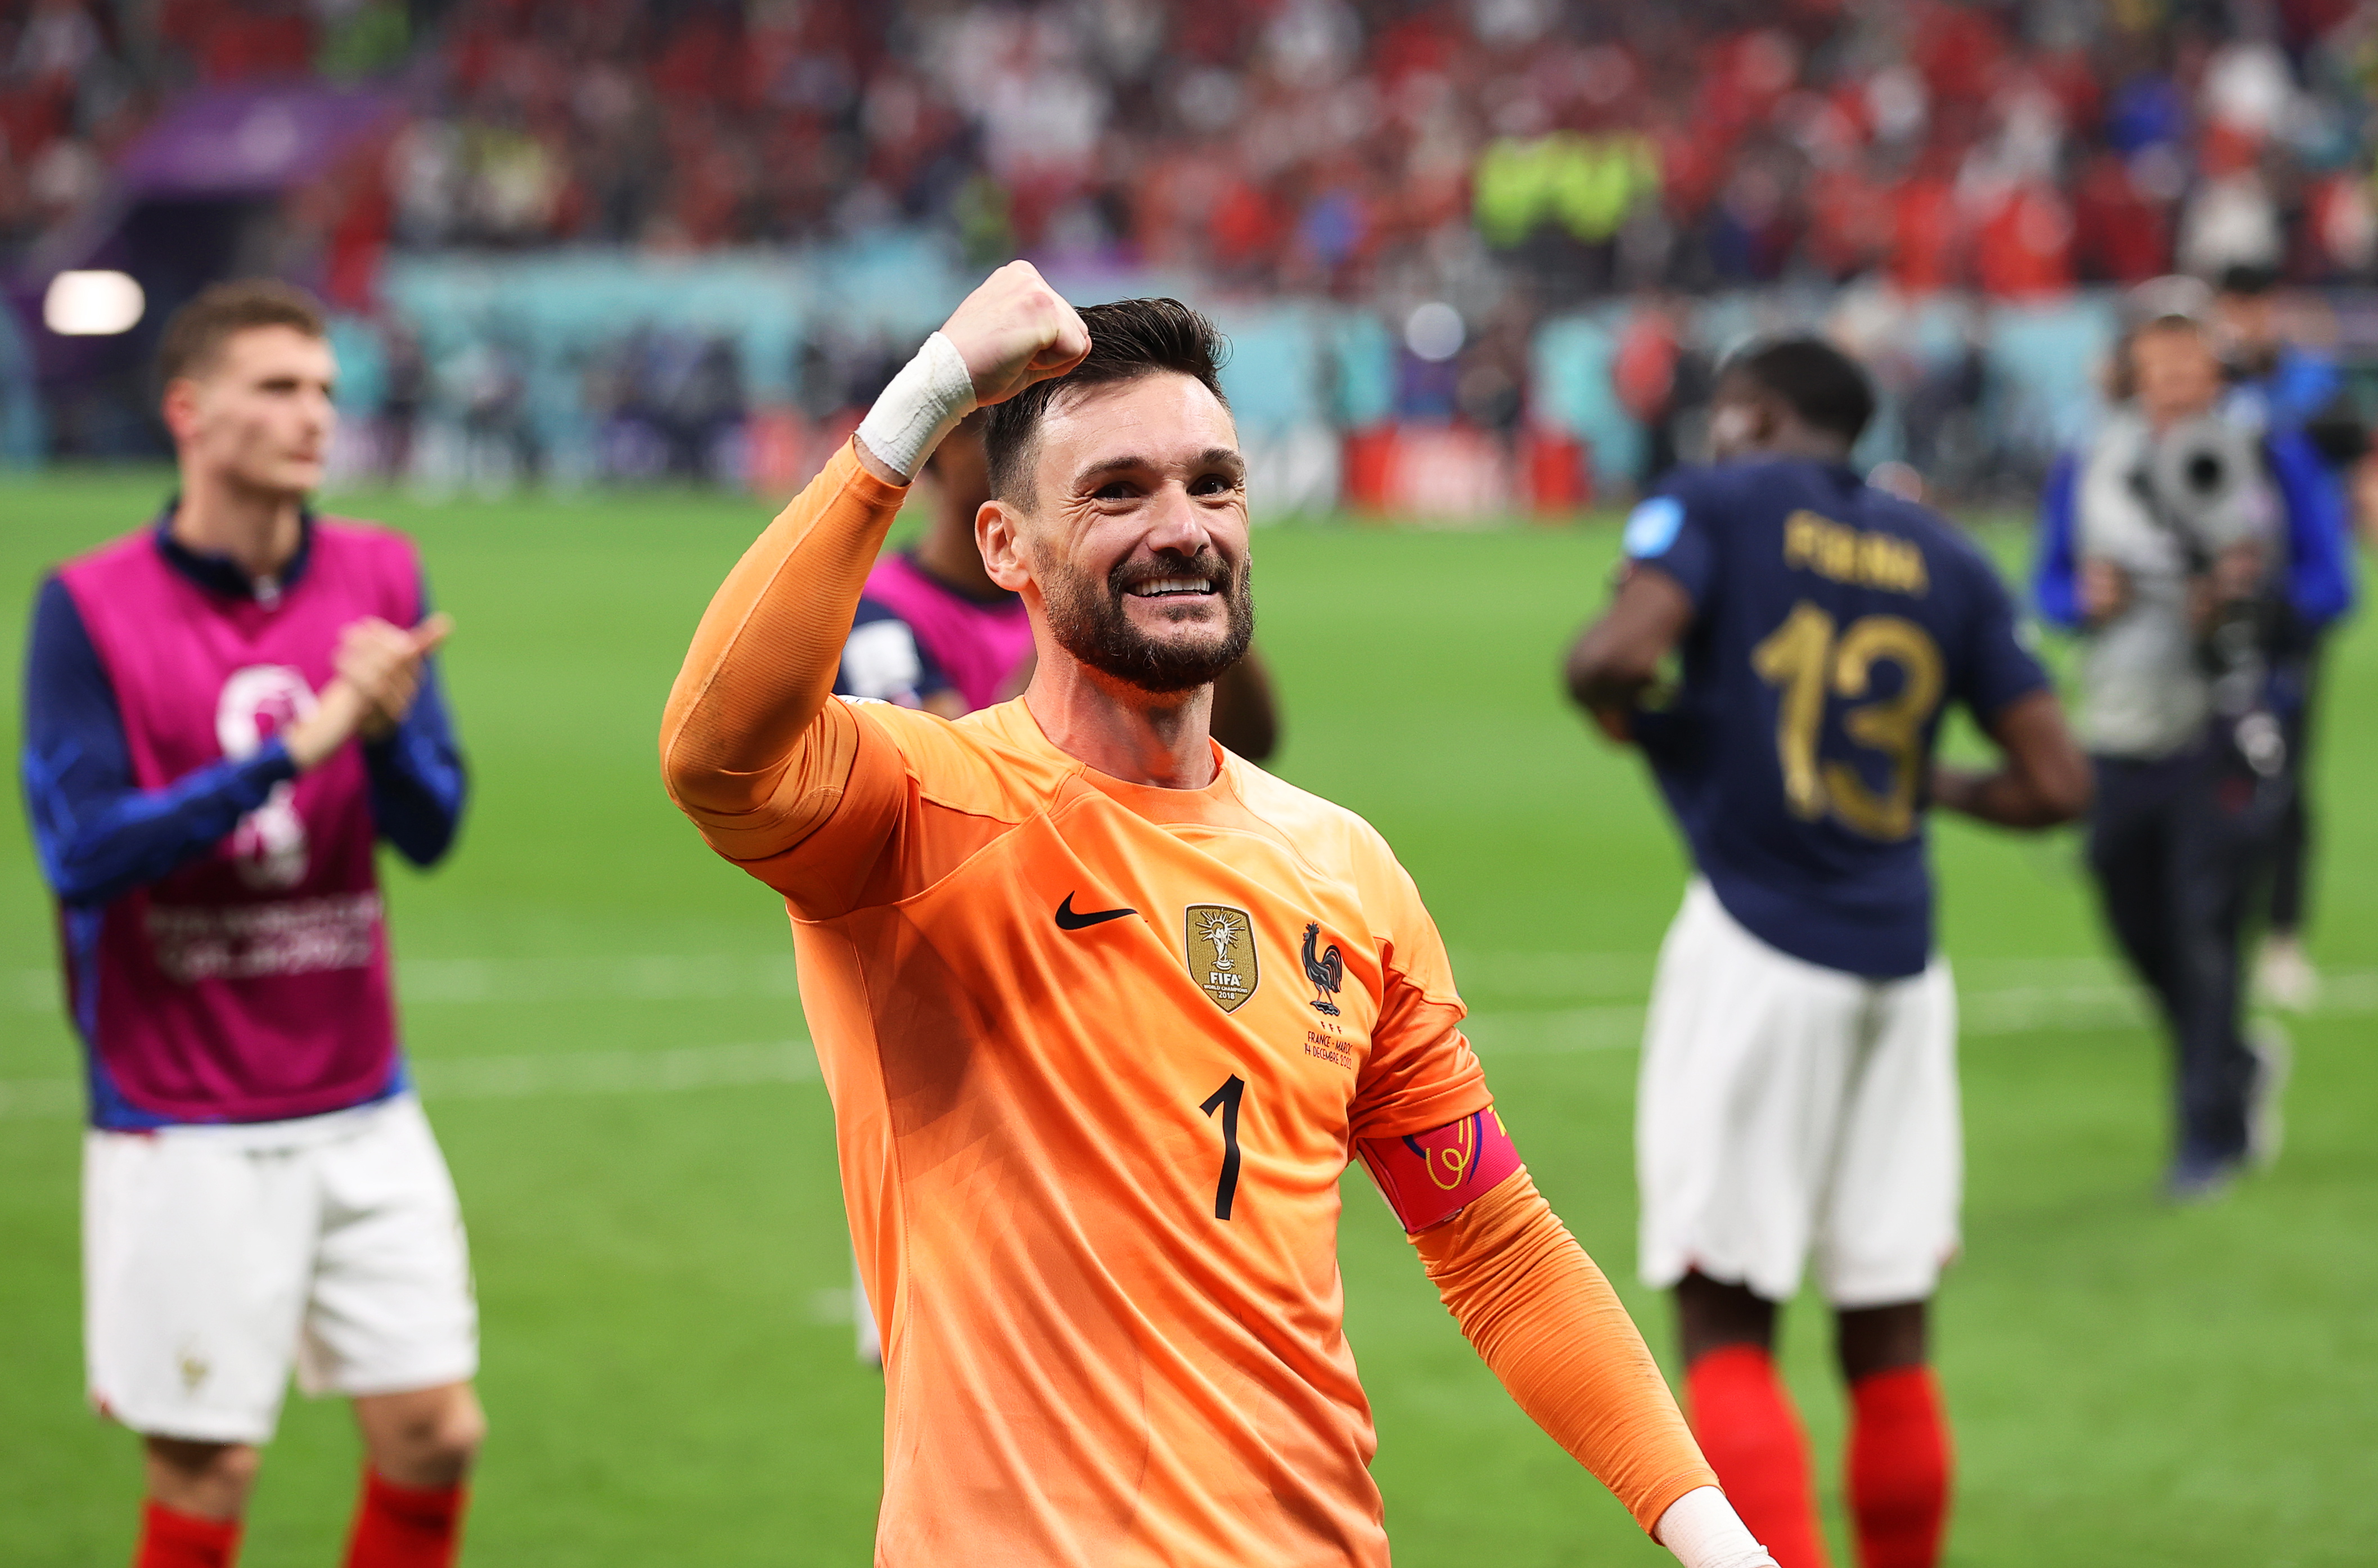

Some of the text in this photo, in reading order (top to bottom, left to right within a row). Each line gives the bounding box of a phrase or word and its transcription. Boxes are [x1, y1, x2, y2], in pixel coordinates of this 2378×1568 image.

[1751, 600, 1945, 841] 13
[1210, 972, 1241, 986] FIFA
[1308, 1030, 1331, 1047] FRANCE
[1304, 1043, 1311, 1055] 14
[1340, 1054, 1352, 1070] 2022
[1199, 1073, 1245, 1220] 1
